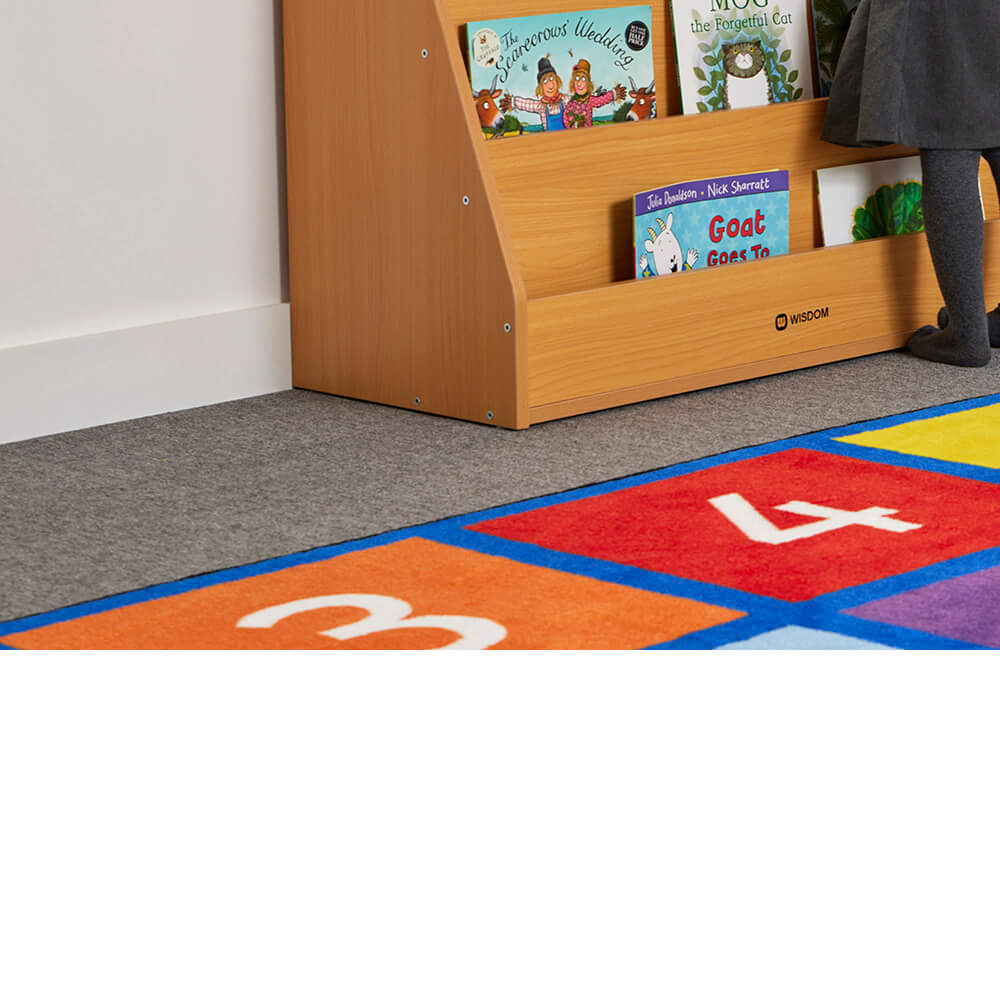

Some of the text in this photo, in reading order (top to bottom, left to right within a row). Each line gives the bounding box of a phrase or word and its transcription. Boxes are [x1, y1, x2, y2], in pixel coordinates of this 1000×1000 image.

[502, 28, 520, 49] The
[690, 11, 793, 33] the Forgetful Cat
[495, 20, 570, 83] Scarecrows'
[574, 16, 634, 71] Wedding
[647, 177, 770, 210] Julia Donaldson Nick Sharratt
[709, 208, 766, 243] Goat
[790, 306, 829, 325] WISDOM
[708, 491, 924, 545] 4
[236, 593, 508, 650] 3
